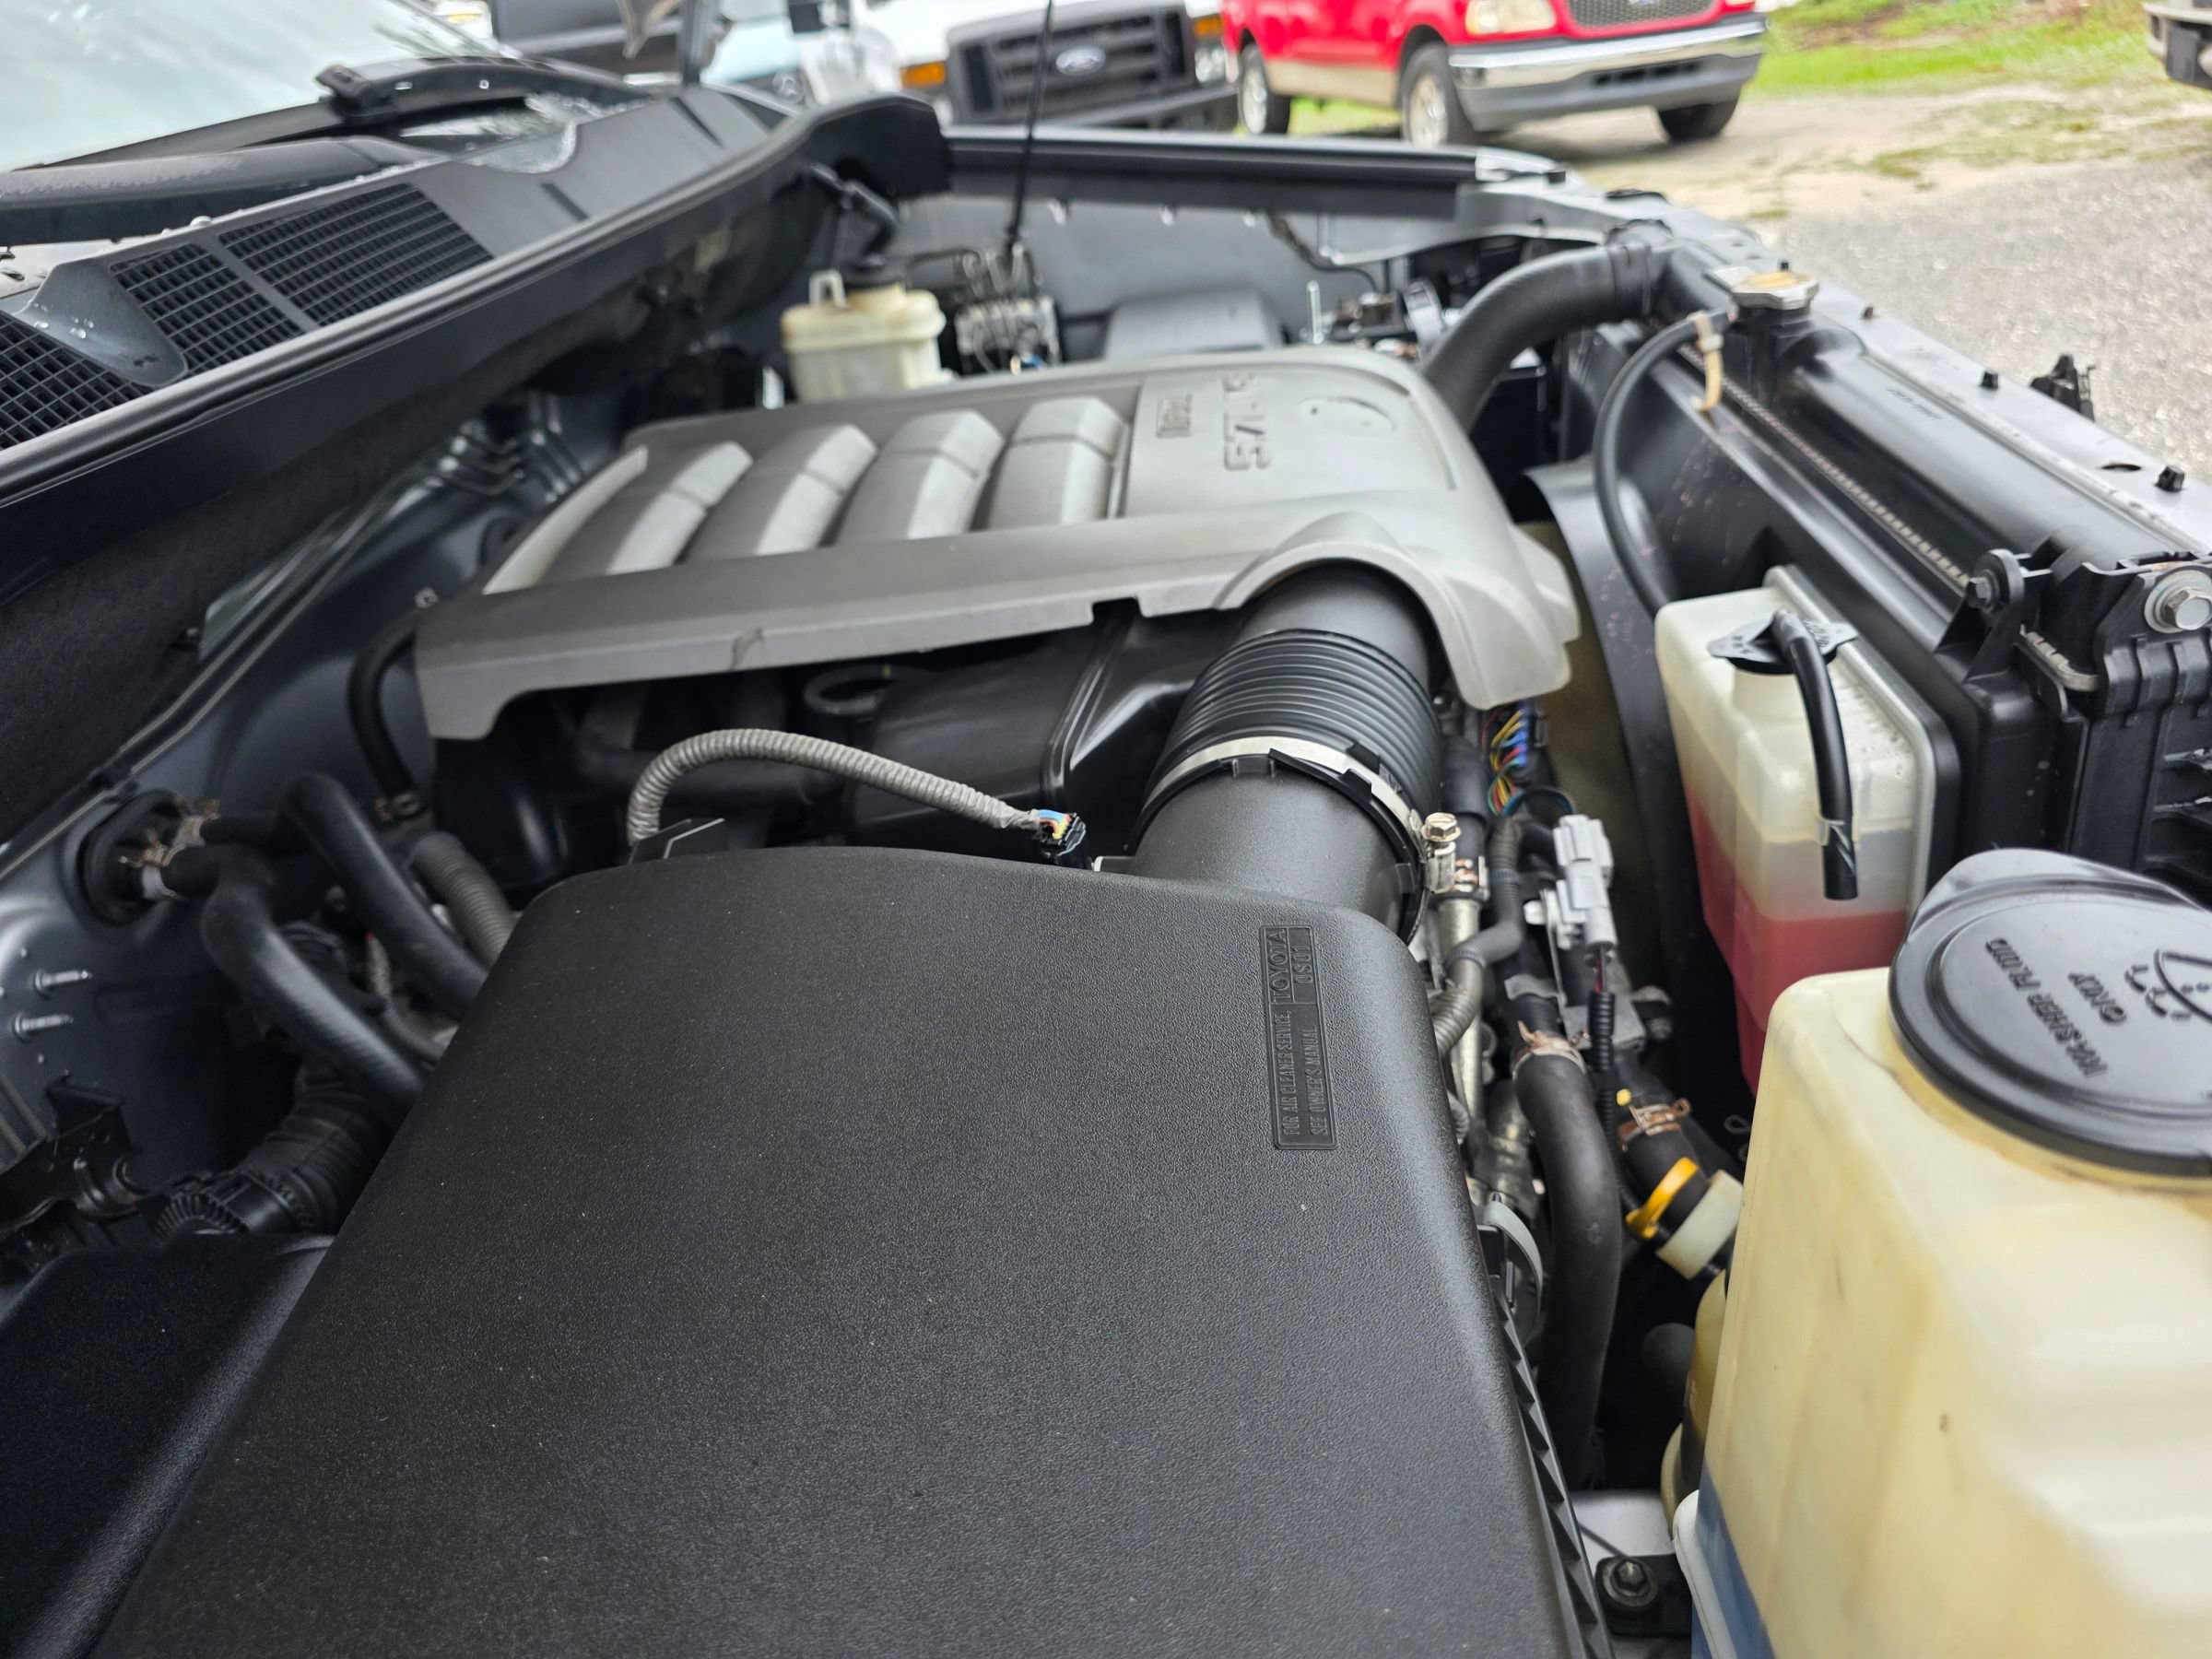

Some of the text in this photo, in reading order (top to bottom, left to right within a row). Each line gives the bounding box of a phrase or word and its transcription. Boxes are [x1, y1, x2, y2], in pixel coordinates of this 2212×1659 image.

[1268, 930, 1291, 1004] TOYOTA
[1984, 938, 2108, 1077] WASHER FLUID
[2068, 973, 2127, 1023] ONLY
[1277, 1053, 1298, 1094] CLEANER
[1301, 1025, 1328, 1135] SEE OWNER'S MANUAL
[1280, 1097, 1299, 1112] AIR
[1282, 1115, 1300, 1135] FOR
